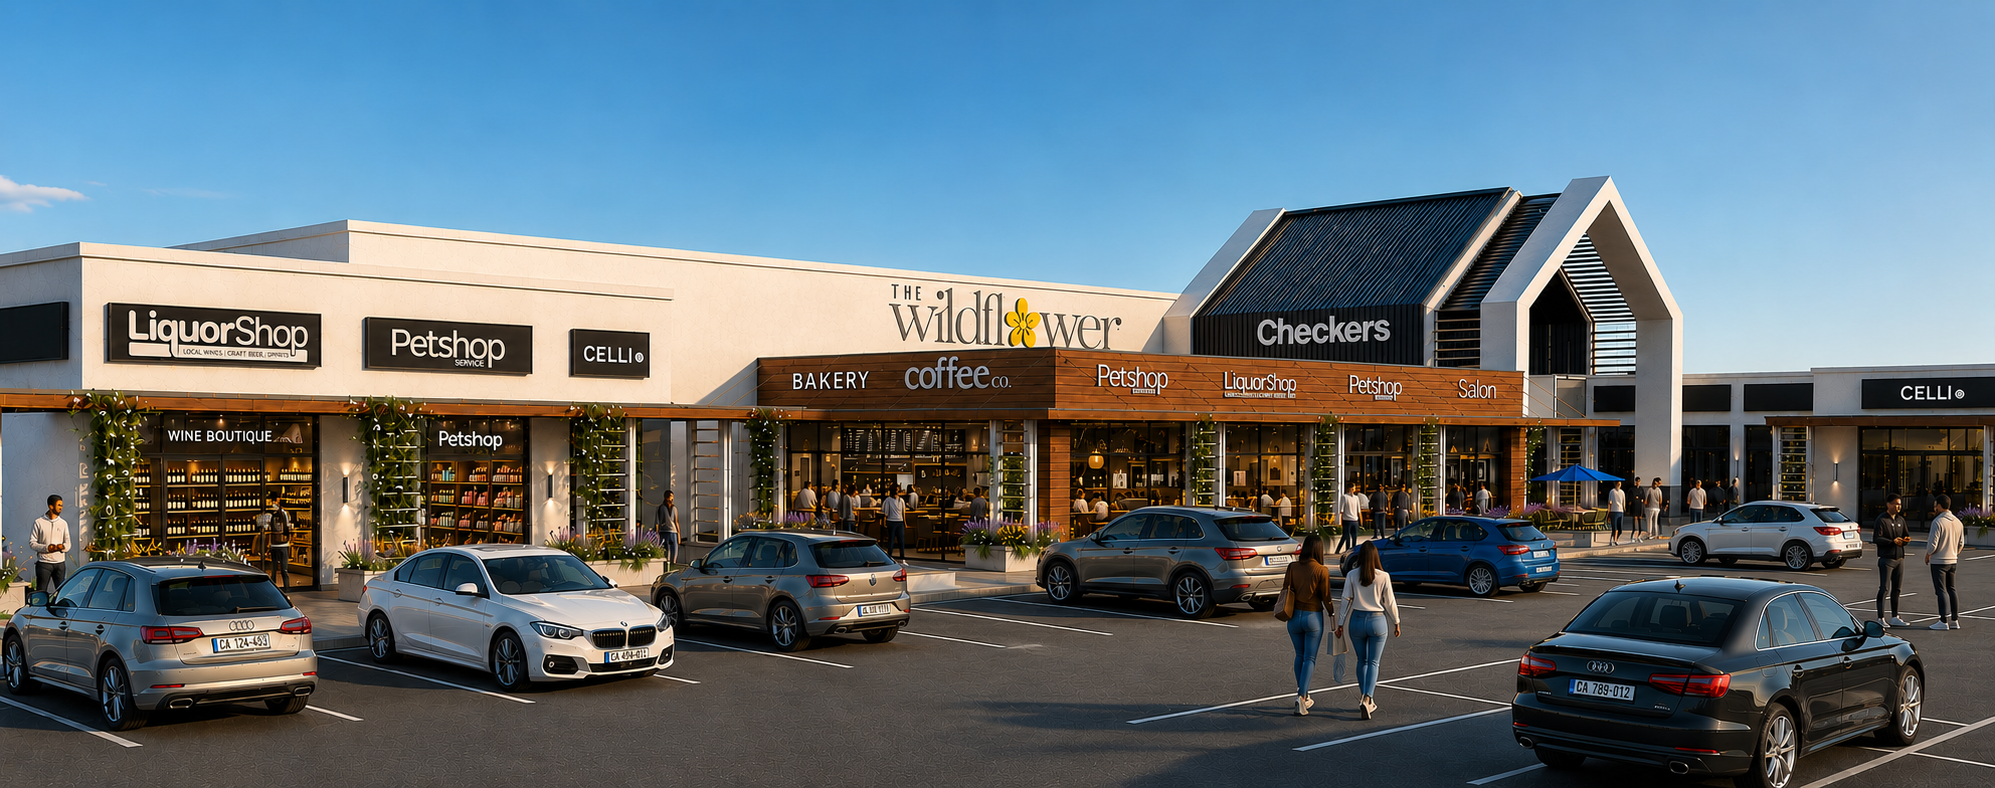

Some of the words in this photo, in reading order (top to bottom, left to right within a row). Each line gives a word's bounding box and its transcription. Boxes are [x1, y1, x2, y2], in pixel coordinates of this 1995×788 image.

[891, 284, 922, 301] THE
[128, 310, 309, 358] LiquorShop
[1257, 315, 1391, 346] Checkers
[391, 328, 506, 368] Petshop
[454, 359, 485, 367] SERVICE
[904, 356, 990, 390] coffee
[792, 371, 869, 390] BAKERY
[1097, 364, 1169, 395] Petshop
[1224, 369, 1297, 398] LiquorShop
[1349, 374, 1403, 401] Petshop
[1458, 378, 1497, 399] Salon
[167, 430, 202, 442] WINE
[206, 430, 272, 444] BOUTIQUE
[438, 430, 503, 451] Petshop
[219, 639, 231, 650] CA
[1576, 679, 1588, 693] CA
[1592, 682, 1630, 698] 789-012
